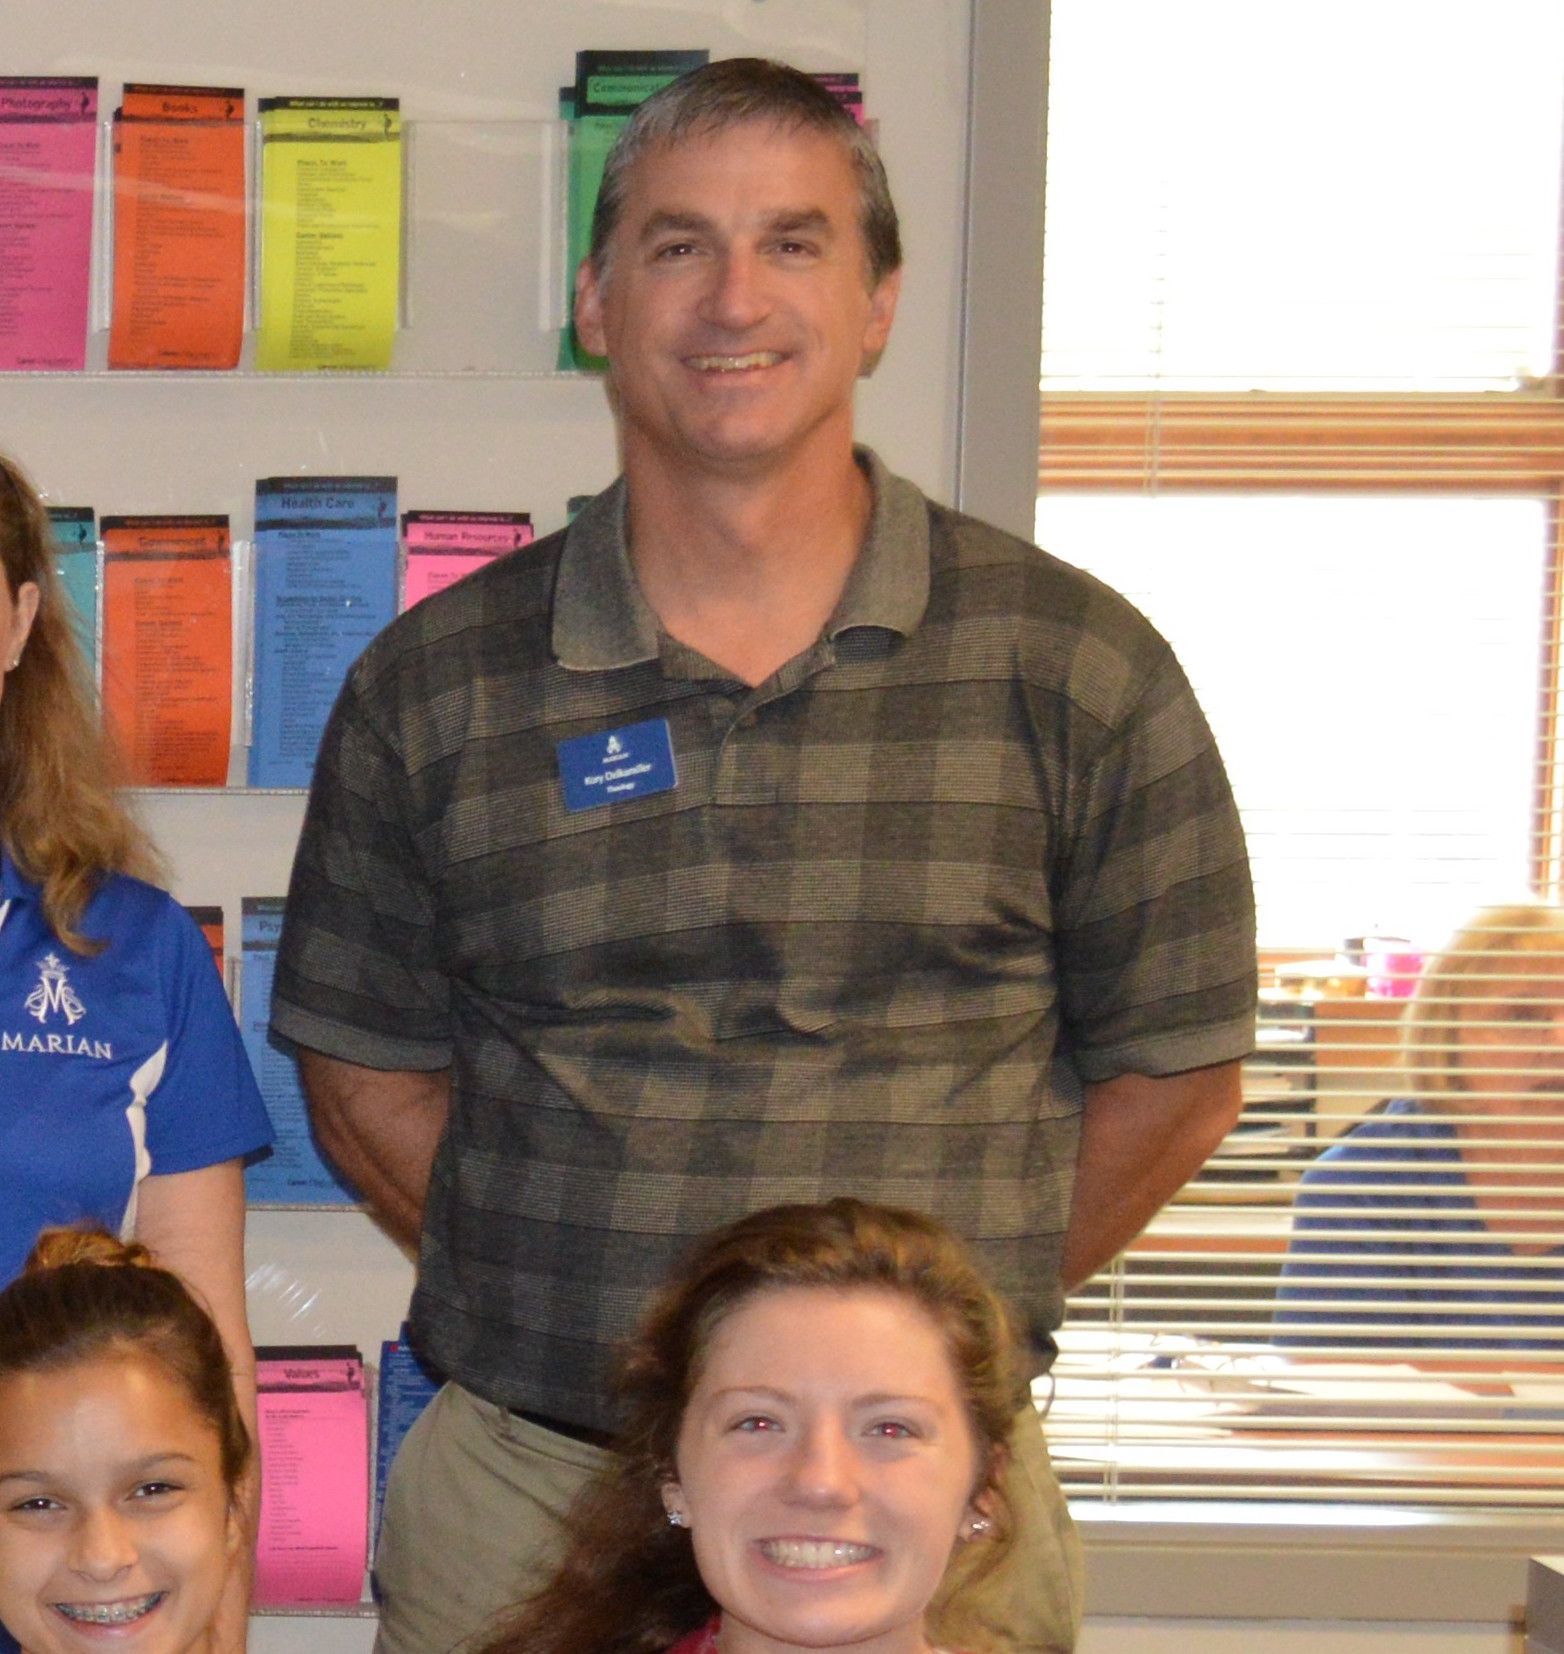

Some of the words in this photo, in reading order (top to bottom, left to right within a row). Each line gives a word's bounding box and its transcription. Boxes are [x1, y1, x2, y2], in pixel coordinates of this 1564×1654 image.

[307, 117, 367, 131] Chemistry
[281, 497, 322, 510] Health
[325, 497, 355, 509] Care
[423, 531, 458, 541] Human
[1, 1031, 113, 1060] MARIAN
